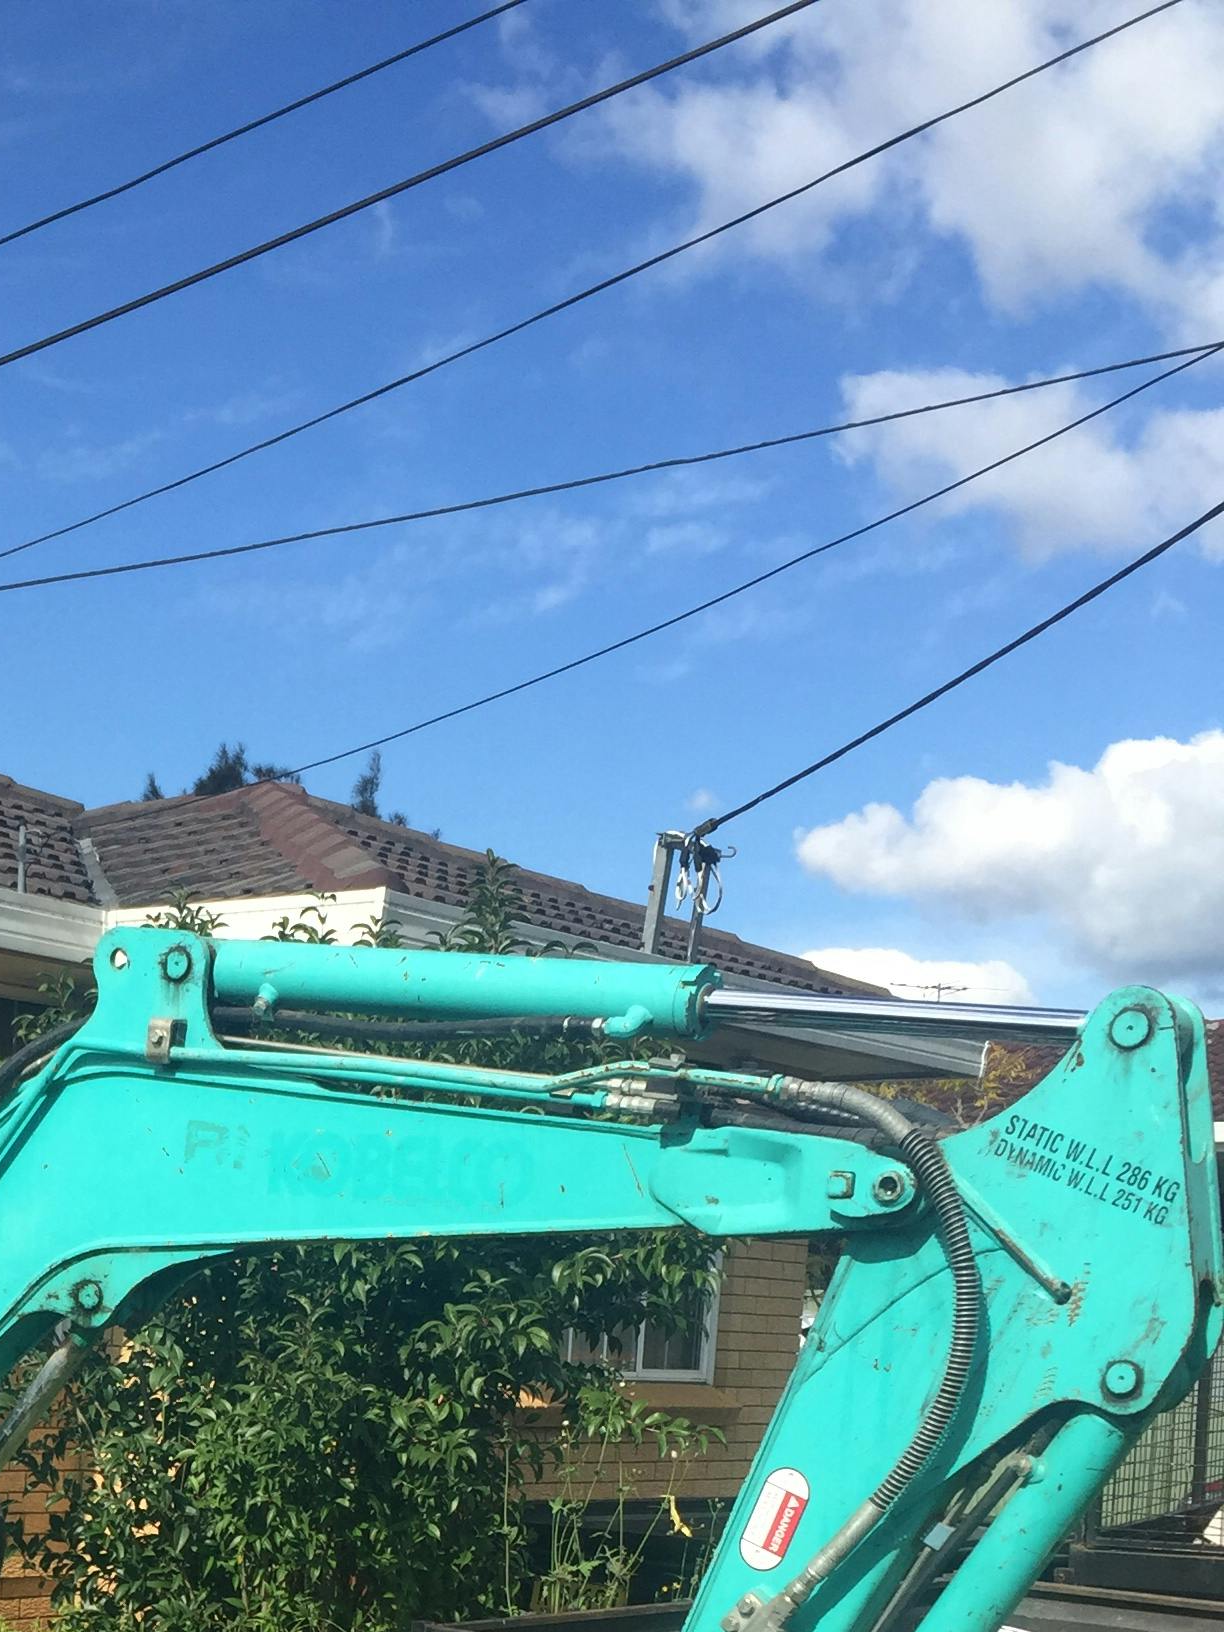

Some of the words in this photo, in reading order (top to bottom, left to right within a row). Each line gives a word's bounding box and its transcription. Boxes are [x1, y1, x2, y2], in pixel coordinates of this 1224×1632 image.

[995, 1138, 1066, 1181] DYNAMIC
[1112, 1188, 1143, 1213] 251
[1143, 1200, 1169, 1225] KG
[1005, 1115, 1064, 1153] STATIC
[1116, 1162, 1151, 1190] 286
[1152, 1176, 1180, 1203] KG
[768, 1507, 796, 1553] DANGER
